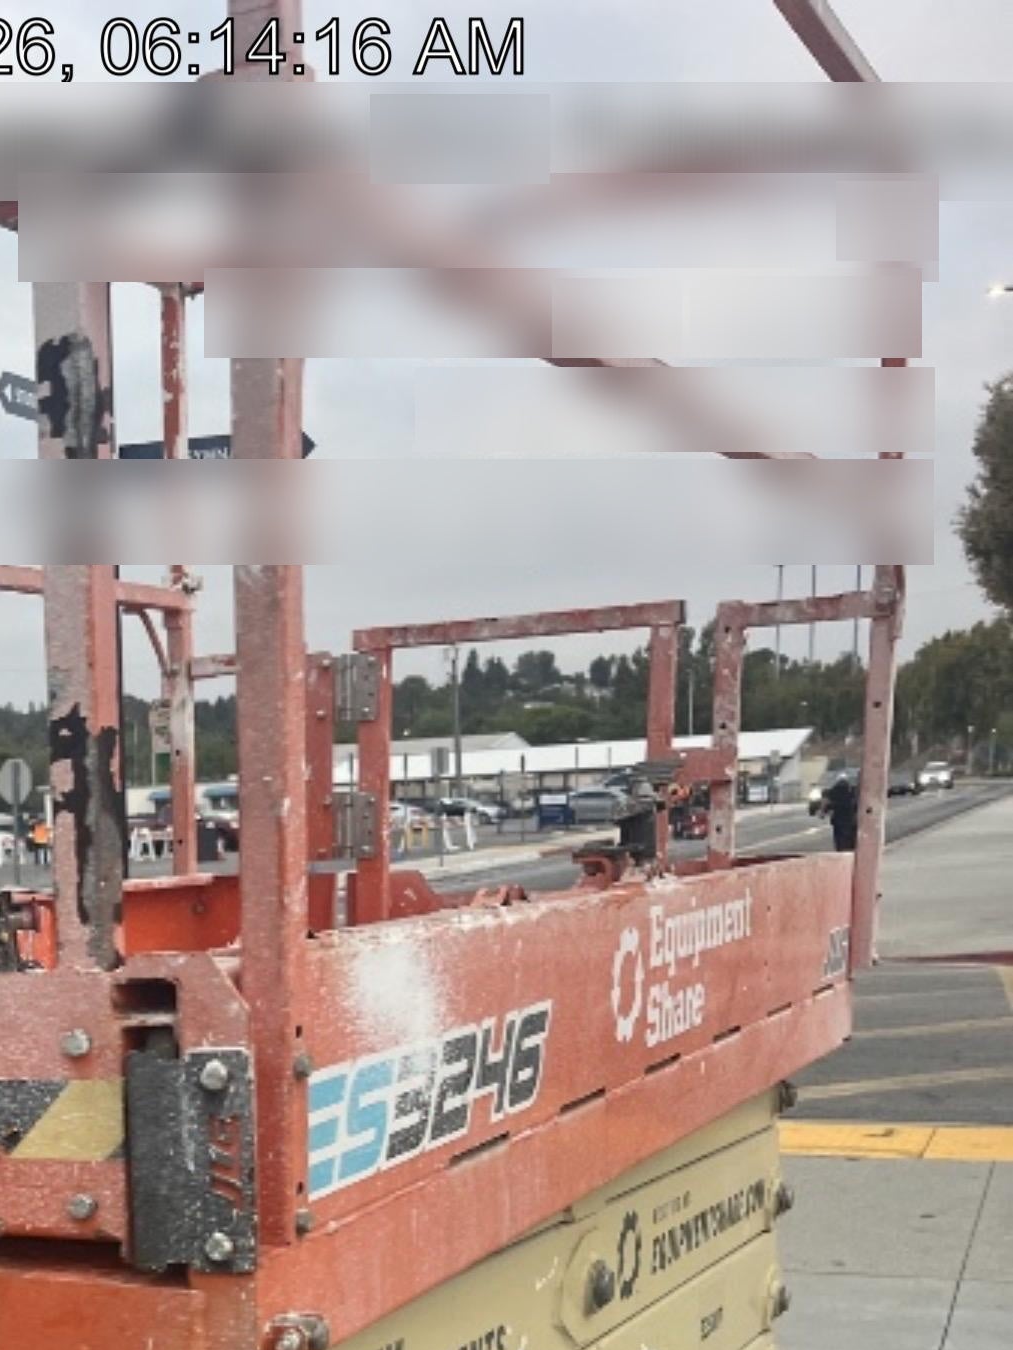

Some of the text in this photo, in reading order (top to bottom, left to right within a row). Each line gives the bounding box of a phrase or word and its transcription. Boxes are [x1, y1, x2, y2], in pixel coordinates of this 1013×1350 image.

[649, 888, 752, 973] Equipment
[645, 981, 706, 1048] Share
[308, 999, 553, 1202] ES3246
